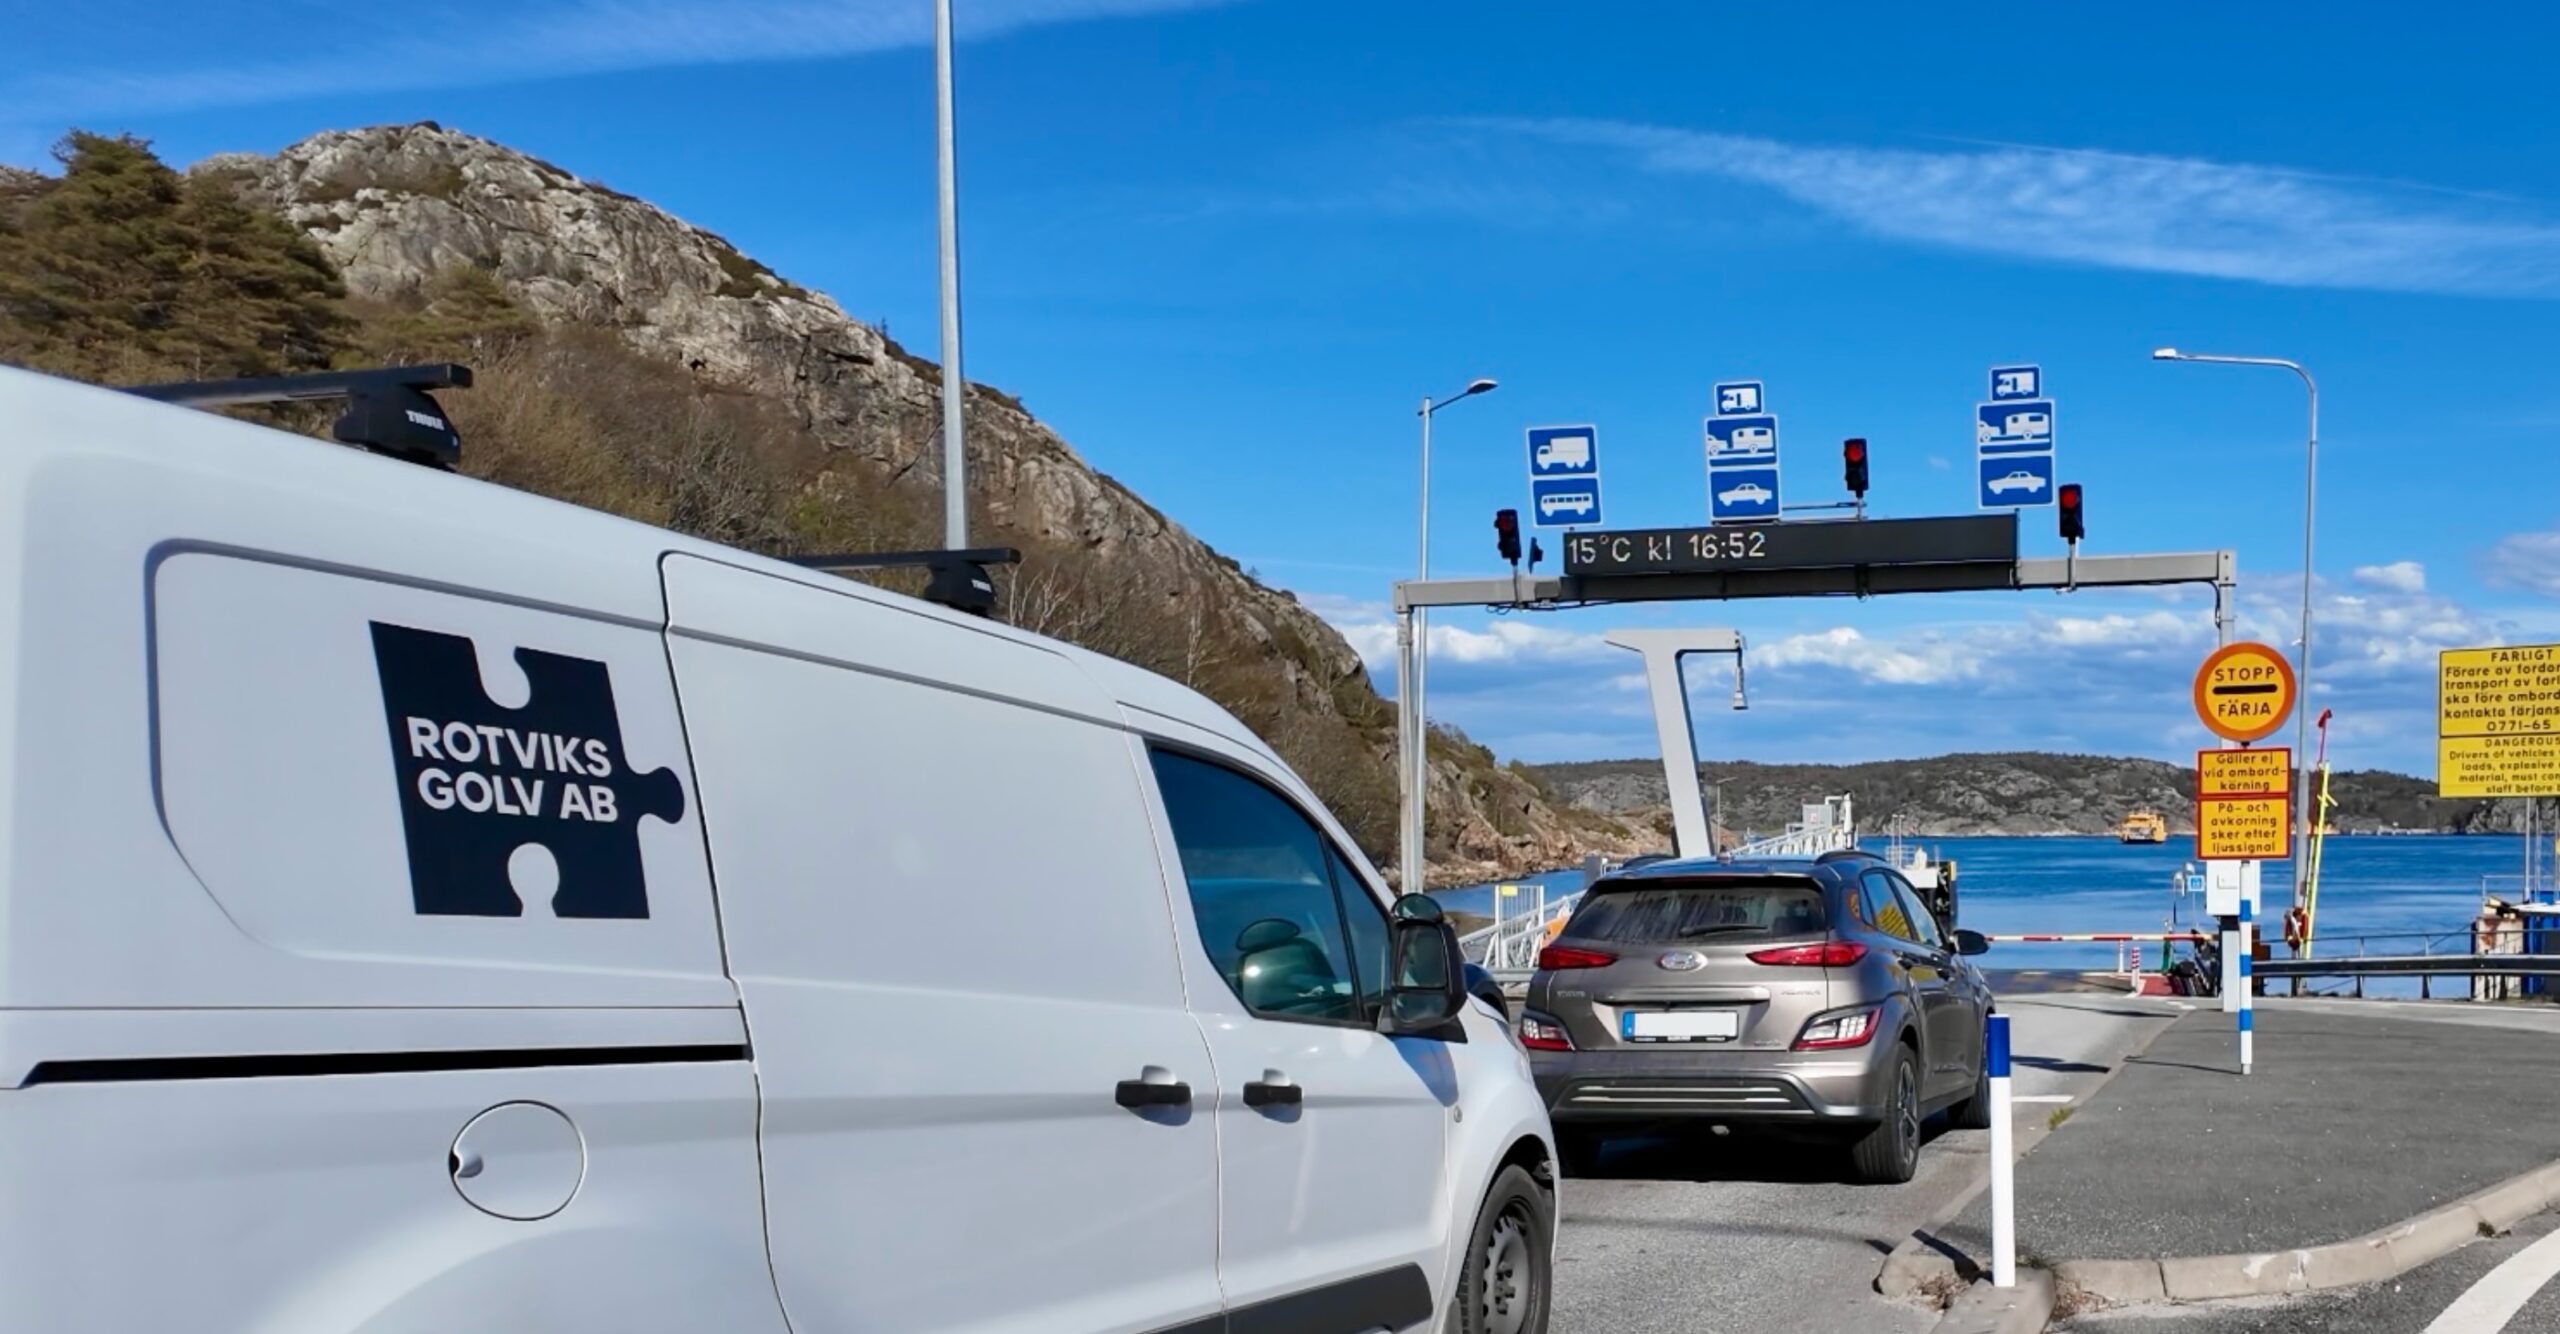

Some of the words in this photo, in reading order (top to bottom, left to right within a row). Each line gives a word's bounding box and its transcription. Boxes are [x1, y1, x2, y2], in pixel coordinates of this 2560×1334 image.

[1568, 534, 1631, 564] 15°C
[1688, 531, 1766, 559] 16:52
[2491, 649, 2553, 662] FARLIGT
[2214, 666, 2275, 682] STOPP
[2445, 666, 2490, 677] Förare
[2495, 666, 2511, 675] av
[2445, 678, 2508, 690] transport
[2514, 679, 2530, 687] av
[2445, 693, 2469, 704] ska
[2475, 692, 2502, 703] före
[2218, 699, 2271, 717] FÄRJA
[2444, 707, 2506, 718] kontakta
[2487, 719, 2551, 731] 0771-65
[407, 716, 612, 778] ROTVIKS
[2216, 752, 2256, 764] Gäller
[2261, 752, 2273, 765] ej
[2449, 750, 2489, 760] Drivers
[2493, 749, 2505, 759] of
[2508, 749, 2554, 758] vehicles
[2499, 761, 2554, 771] explosive
[2204, 768, 2223, 778] vid
[2228, 767, 2287, 777] ombord-
[2512, 773, 2537, 781] must
[2220, 780, 2270, 792] körning
[2486, 784, 2512, 794] staff
[2515, 783, 2553, 793] before
[417, 768, 544, 817] GOLV
[559, 783, 619, 823] AB
[2218, 802, 2241, 813] På-
[2247, 802, 2270, 813] och
[2211, 815, 2277, 828] avkörning
[2210, 829, 2240, 840] sker
[2244, 828, 2277, 839] efter
[2213, 841, 2275, 854] ljussignal
